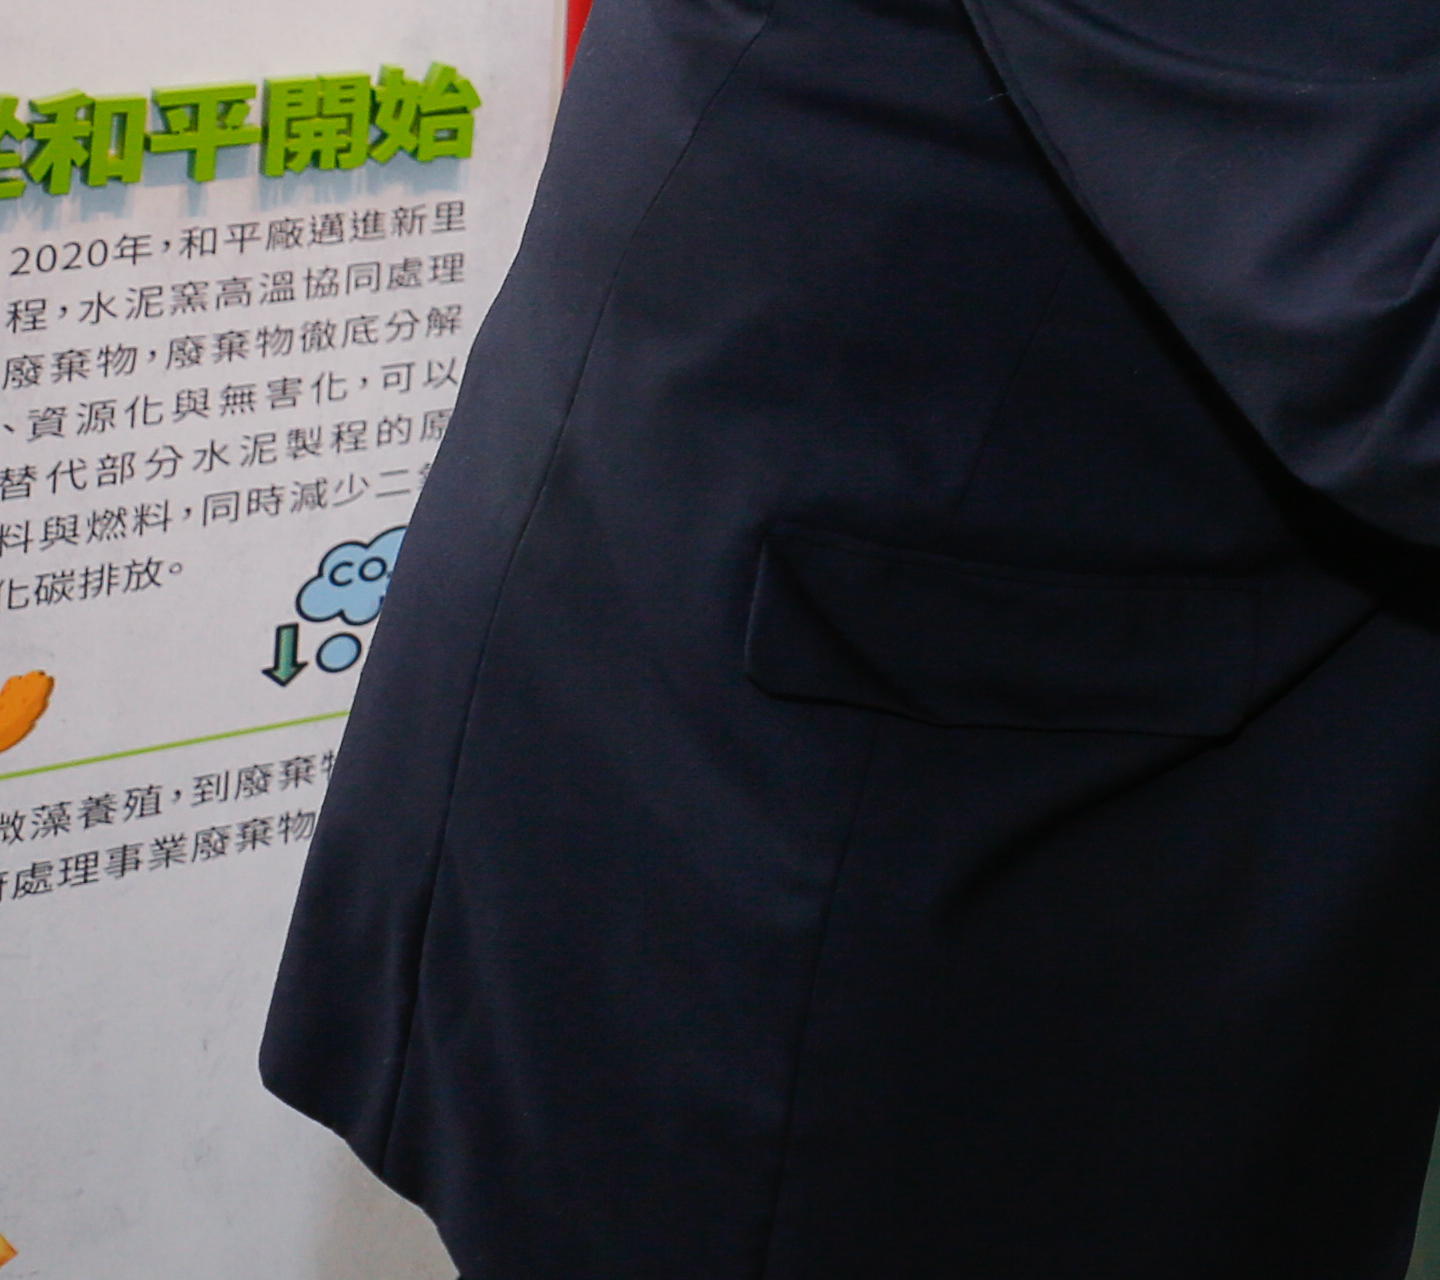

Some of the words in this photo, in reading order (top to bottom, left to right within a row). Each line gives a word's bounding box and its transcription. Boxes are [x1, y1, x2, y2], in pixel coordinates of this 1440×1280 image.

[0, 461, 433, 558] 料與燃料，同時減少二
[0, 810, 316, 904] 處理事業廢棄物
